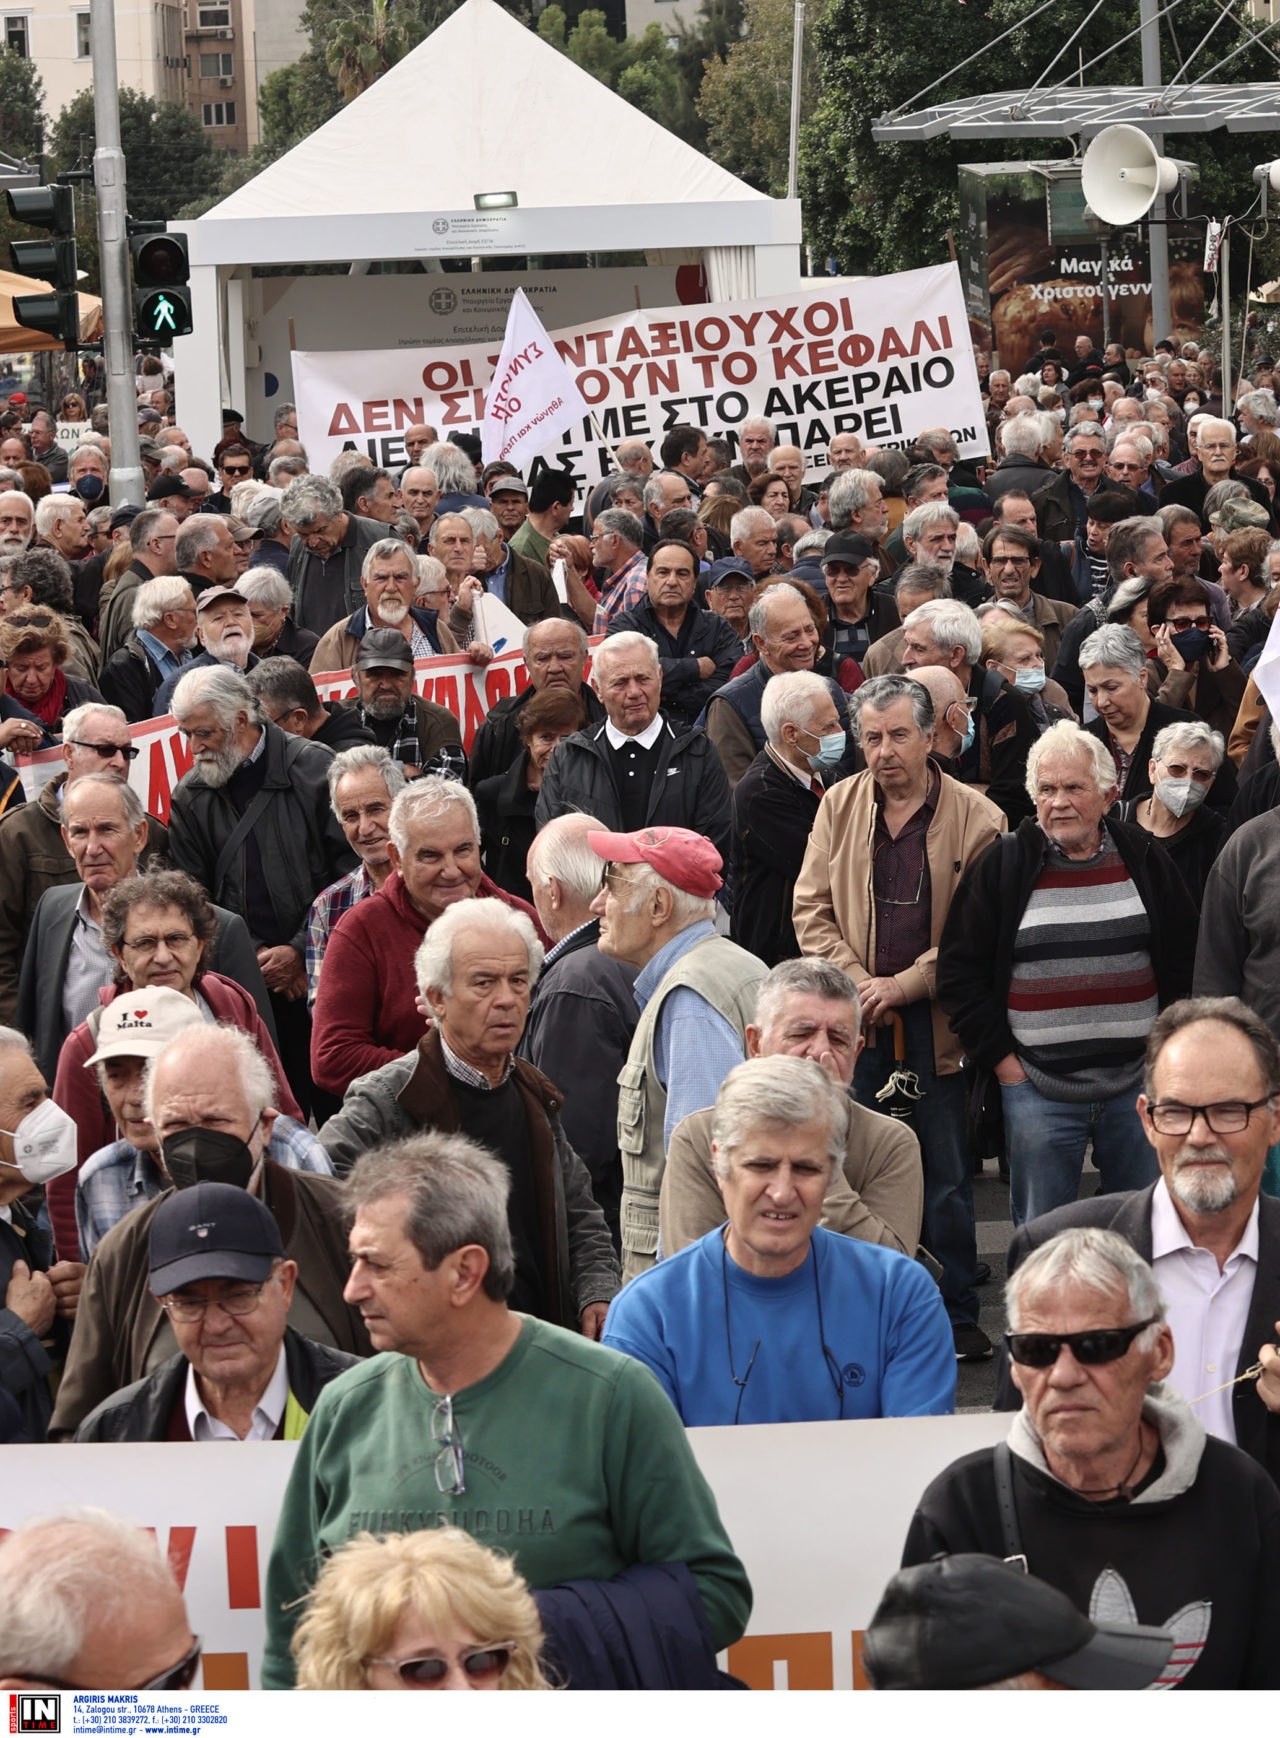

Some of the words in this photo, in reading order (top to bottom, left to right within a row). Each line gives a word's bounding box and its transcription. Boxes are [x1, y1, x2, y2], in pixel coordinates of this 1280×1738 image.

[1060, 255, 1134, 277] Μαγκά
[461, 287, 501, 295] ΕΛΛΗΝΙΚΗ
[504, 286, 557, 294] ΔΗΟΚΡΑΤΙΑ
[422, 359, 473, 392] ΟΙ
[487, 297, 854, 386] ΝΤΑΞΙΟΥΧΟΙ
[327, 397, 426, 437] ΔΕΝ
[692, 351, 757, 389] ΤΟ
[771, 315, 953, 381] ΚΕΦΑΛΙ
[660, 391, 749, 431] ΣΤΟ
[763, 356, 955, 418] ΑΚΕΡΑΙΟ
[117, 1020, 152, 1030] Malta
[120, 1012, 129, 1021] I
